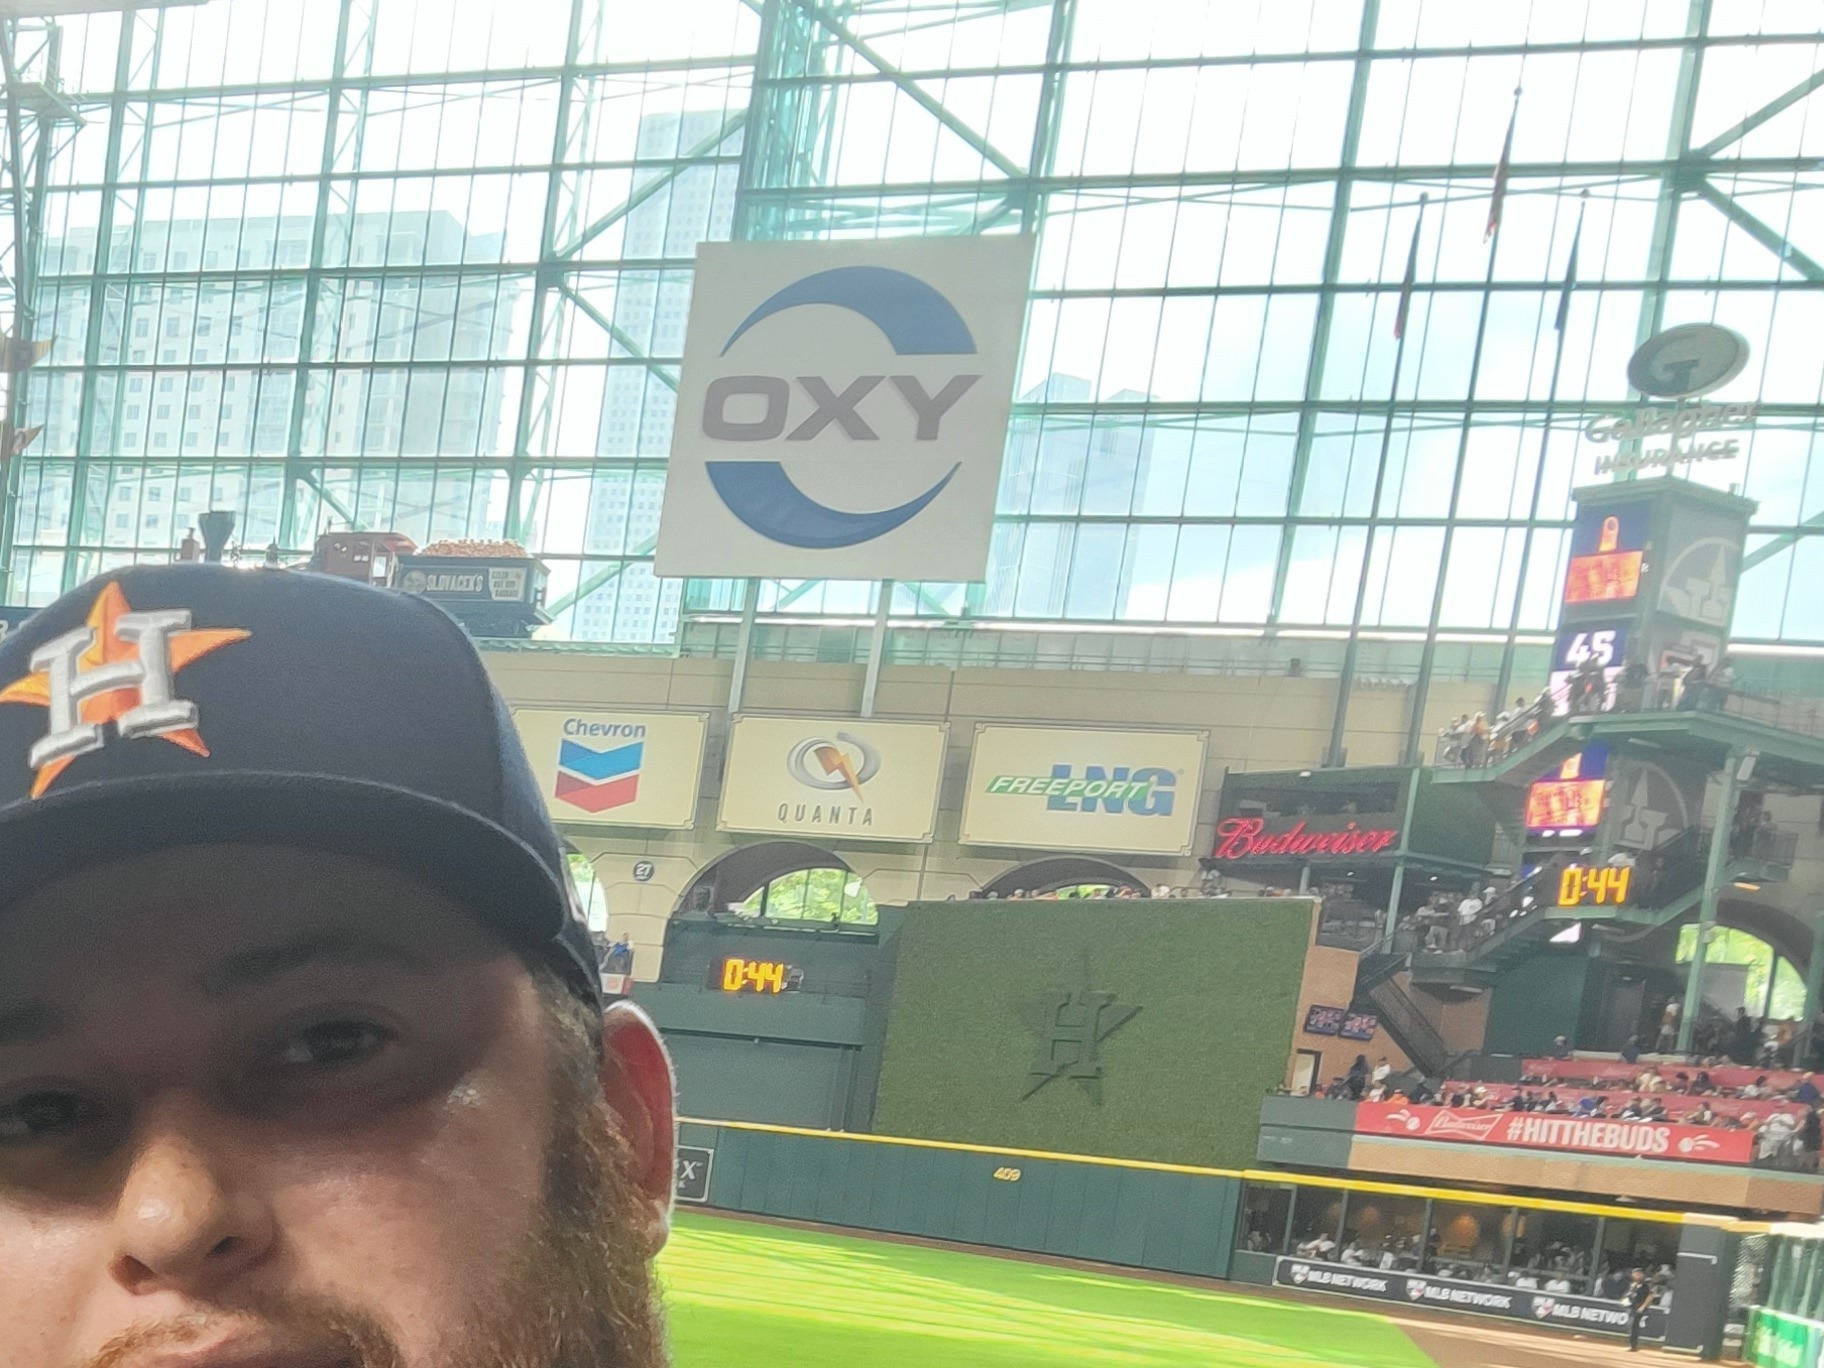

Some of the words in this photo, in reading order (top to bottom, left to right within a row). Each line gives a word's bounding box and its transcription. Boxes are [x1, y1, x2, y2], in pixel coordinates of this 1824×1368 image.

[702, 374, 982, 441] OXY
[1594, 439, 1740, 475] INSURANCE
[1565, 630, 1617, 667] 45
[30, 608, 199, 768] H
[563, 718, 646, 738] Chevron
[991, 776, 1148, 798] FREEPORT
[1046, 764, 1176, 817] LNG
[778, 803, 873, 826] QUANTA
[1215, 817, 1399, 859] Budweiser
[1558, 867, 1631, 906] 0:44
[723, 959, 784, 993] 0:44
[1506, 1117, 1671, 1153] #HITTHEBUDS
[993, 1167, 1021, 1181] 409
[1307, 1270, 1332, 1284] MLB
[1331, 1273, 1388, 1292] NETWORK
[1424, 1286, 1451, 1300] MLB
[1449, 1289, 1512, 1309] NETWORK
[1552, 1304, 1581, 1318] MLB
[1580, 1307, 1649, 1328] NETWOK
